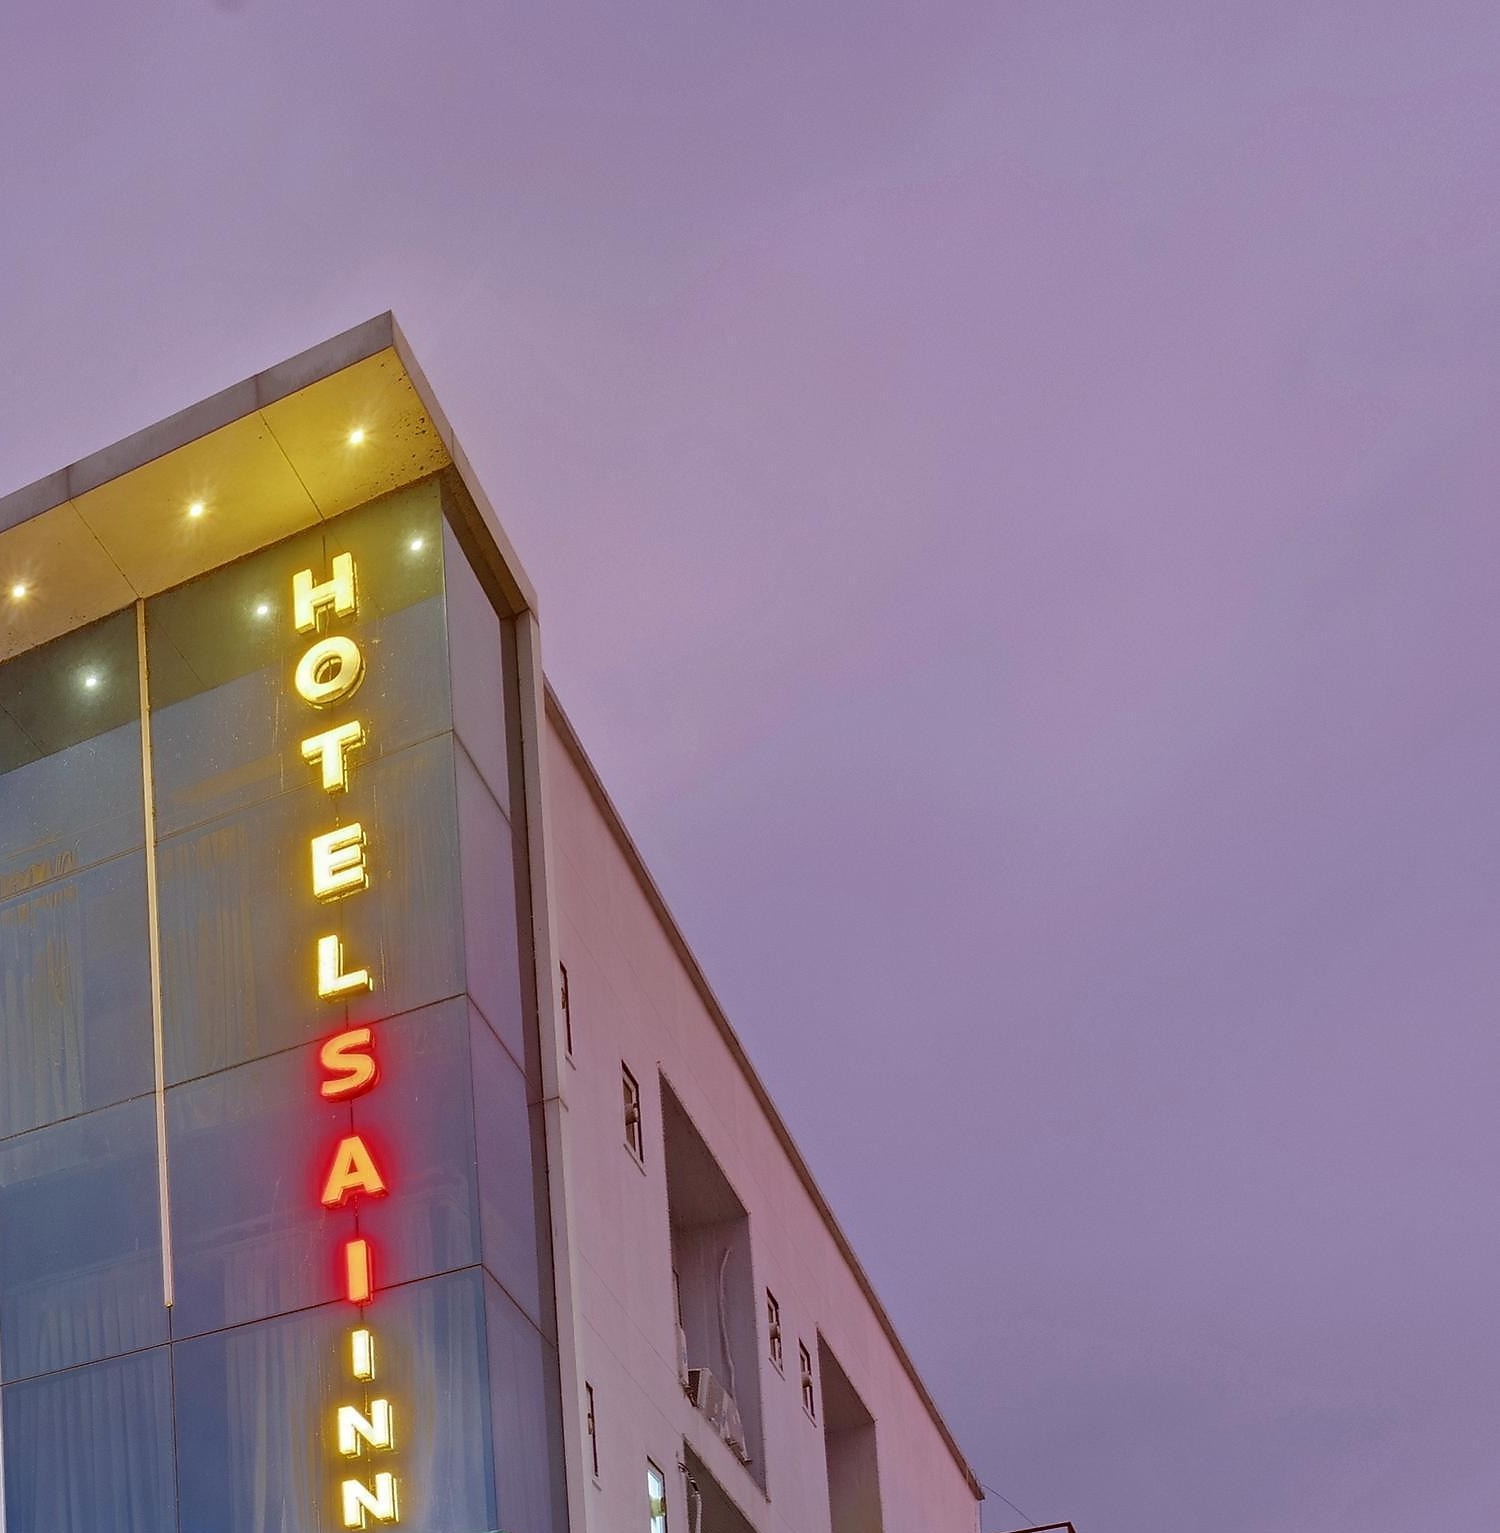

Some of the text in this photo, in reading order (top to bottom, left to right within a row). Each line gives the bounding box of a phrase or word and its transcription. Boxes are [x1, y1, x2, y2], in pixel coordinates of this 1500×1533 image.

[292, 551, 399, 1530] HOTEL SAI INN
